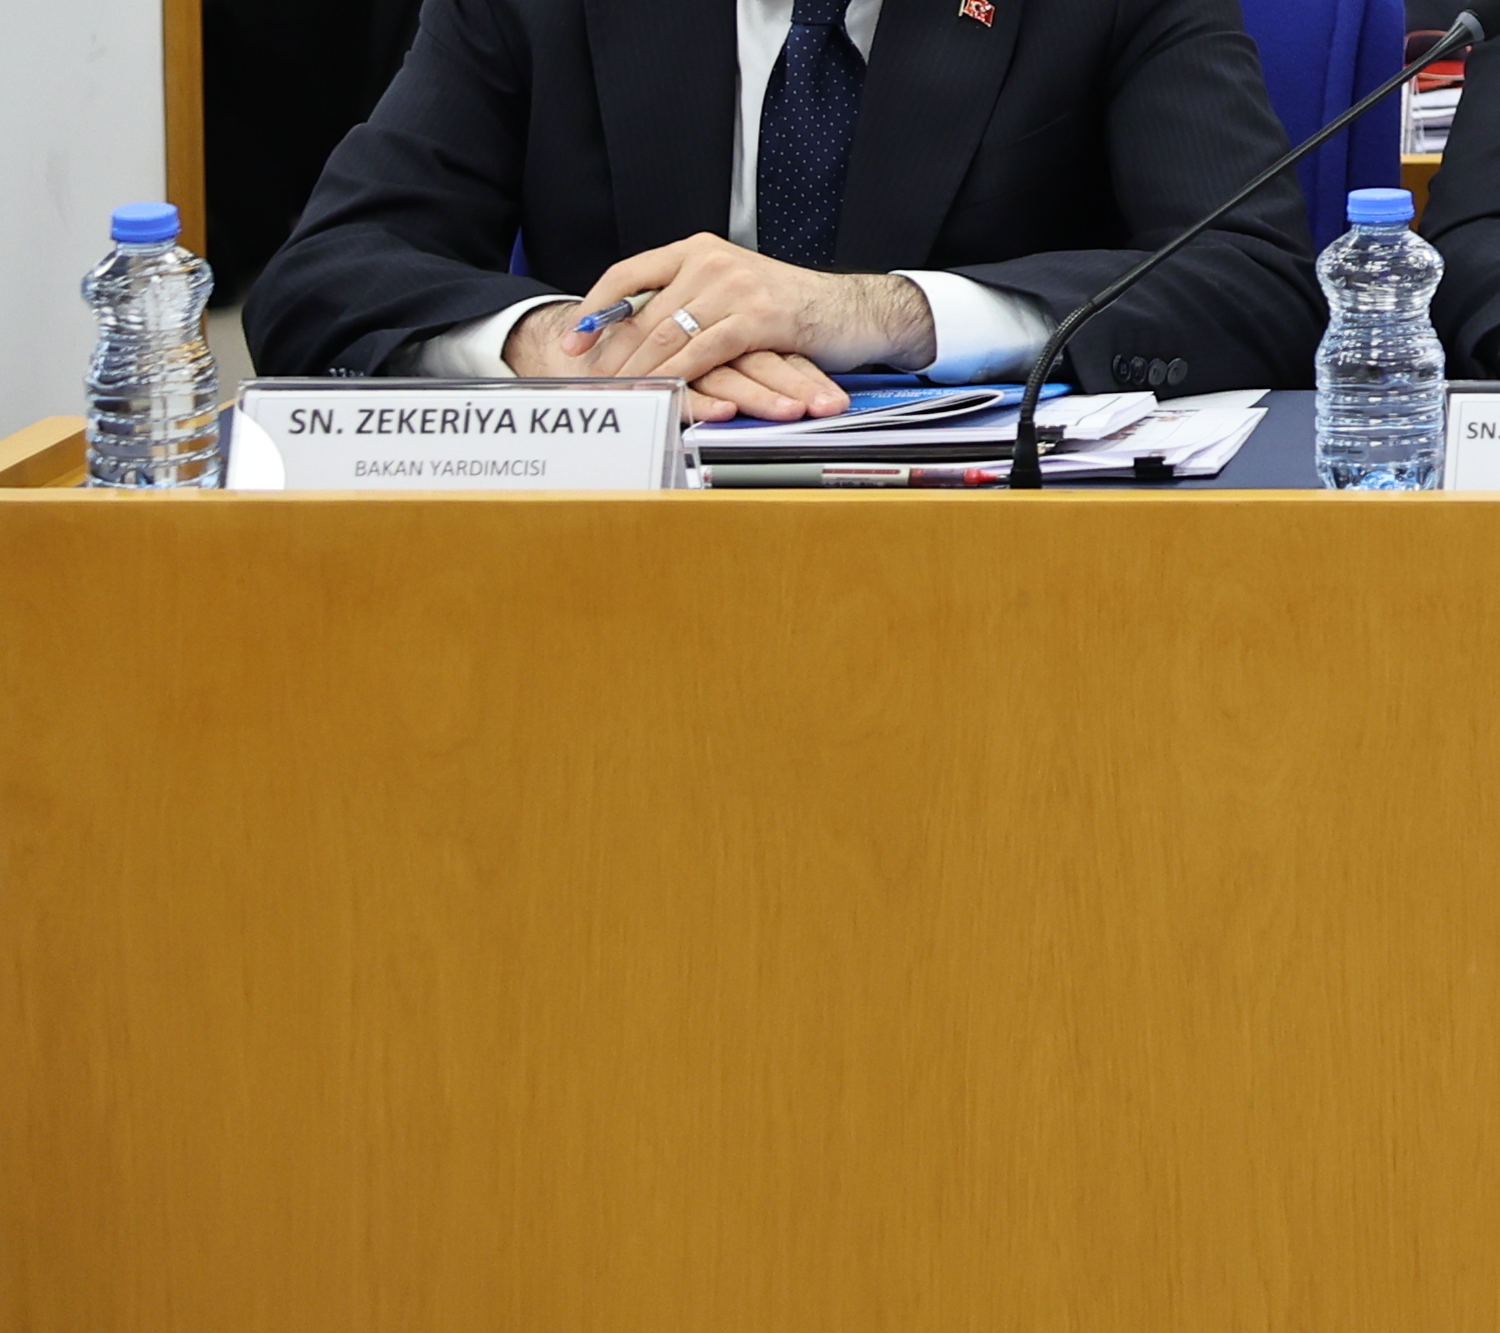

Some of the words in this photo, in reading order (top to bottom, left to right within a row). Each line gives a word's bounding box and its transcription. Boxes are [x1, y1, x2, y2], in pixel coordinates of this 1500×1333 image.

[288, 408, 343, 435] SN.
[355, 401, 517, 435] ZEKERİYA
[529, 408, 621, 434] KAYA
[354, 460, 424, 477] BAKAN
[430, 459, 547, 477] YARDIMCISI
